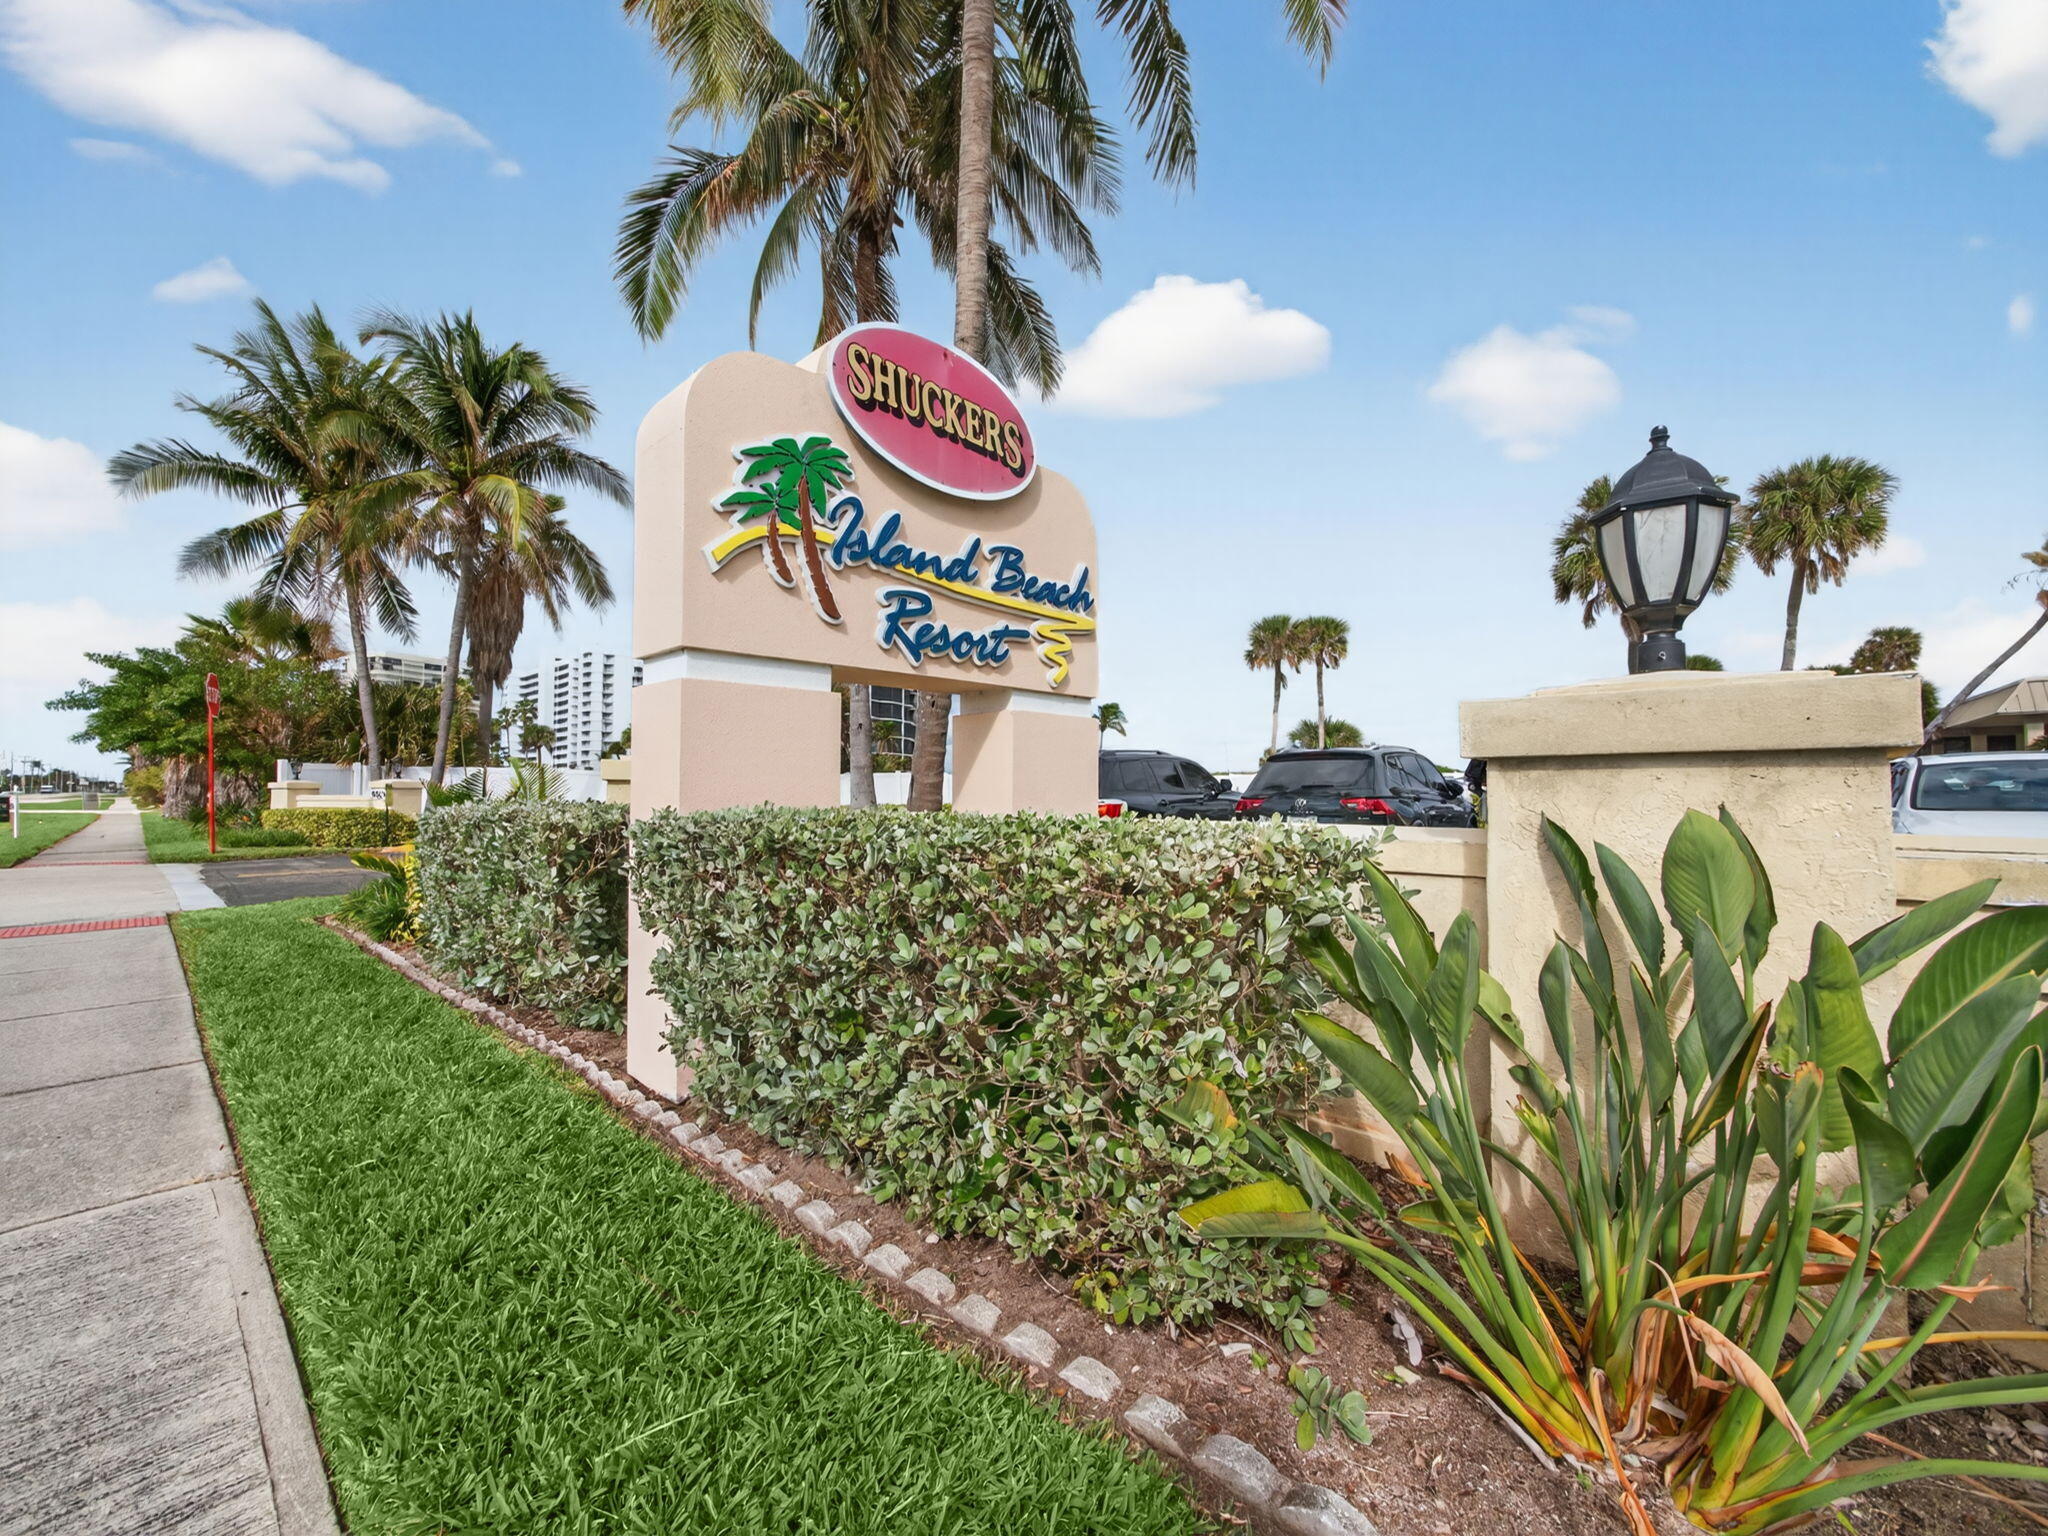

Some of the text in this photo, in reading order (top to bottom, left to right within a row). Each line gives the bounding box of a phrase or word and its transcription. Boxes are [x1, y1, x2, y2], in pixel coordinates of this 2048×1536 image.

[847, 342, 1025, 476] SHUCKERS
[829, 496, 1095, 612] Island Beach
[882, 589, 1031, 663] Resort
